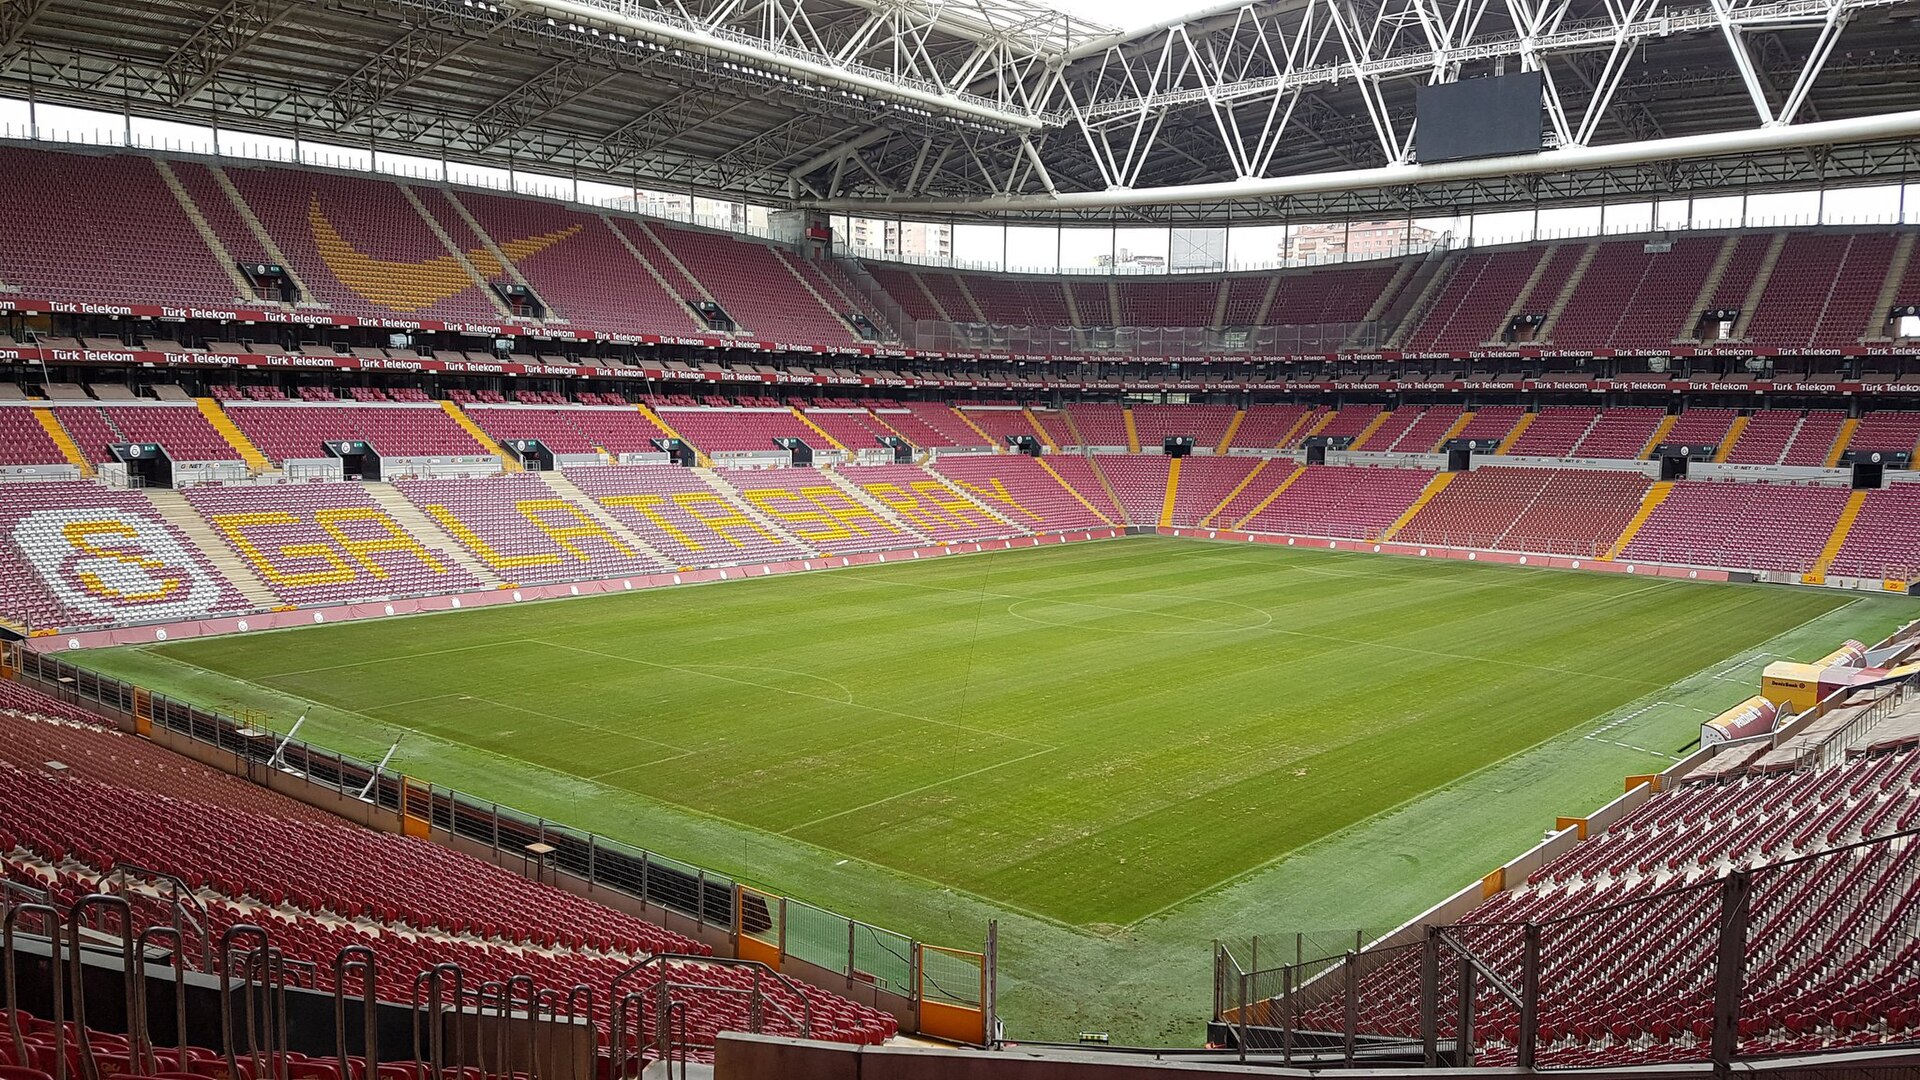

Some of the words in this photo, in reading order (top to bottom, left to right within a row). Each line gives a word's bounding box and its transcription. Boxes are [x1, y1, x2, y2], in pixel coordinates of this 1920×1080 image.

[50, 302, 76, 312] Türk
[81, 303, 132, 315] Telekom
[161, 307, 186, 317] Türk
[190, 309, 237, 320] Telekom
[264, 312, 286, 322] Türk
[290, 313, 333, 324] Telekom
[357, 316, 378, 326] Türk
[381, 317, 421, 329] Telekom
[443, 322, 462, 331] Türk
[465, 324, 501, 334] Telekom
[522, 327, 540, 336] Türk
[542, 328, 575, 338] Telekom
[595, 331, 610, 340] Türk
[613, 332, 642, 342] Telekom
[660, 335, 674, 344] Türk
[677, 336, 704, 345] Telekom
[735, 340, 761, 349] Telekom
[789, 343, 813, 351] Telekom
[826, 345, 837, 353] Türk
[839, 346, 861, 354] Telekom
[52, 350, 78, 360] Türk
[83, 350, 134, 361] Telekom
[1559, 349, 1593, 357] Telekom
[1693, 348, 1712, 356] Türk
[1715, 348, 1753, 356] Telekom
[1866, 347, 1887, 355] Türk
[164, 353, 188, 362] Türk
[193, 353, 239, 364] Telekom
[265, 356, 288, 365] Türk
[292, 356, 334, 366] Telekom
[358, 358, 379, 368] Türk
[382, 359, 422, 369] Telekom
[445, 362, 463, 371] Türk
[466, 363, 502, 372] Telekom
[523, 365, 541, 373] Türk
[543, 365, 577, 374] Telekom
[596, 367, 611, 376] Türk
[613, 368, 643, 377] Telekom
[661, 370, 675, 378] Türk
[677, 370, 705, 379] Telekom
[721, 372, 734, 380] Türk
[736, 373, 762, 381] Telekom
[790, 375, 813, 383] Telekom
[839, 376, 862, 384] Telekom
[1688, 382, 1707, 390] Türk
[1710, 382, 1748, 390] Telekom
[1796, 383, 1836, 391] Telekom
